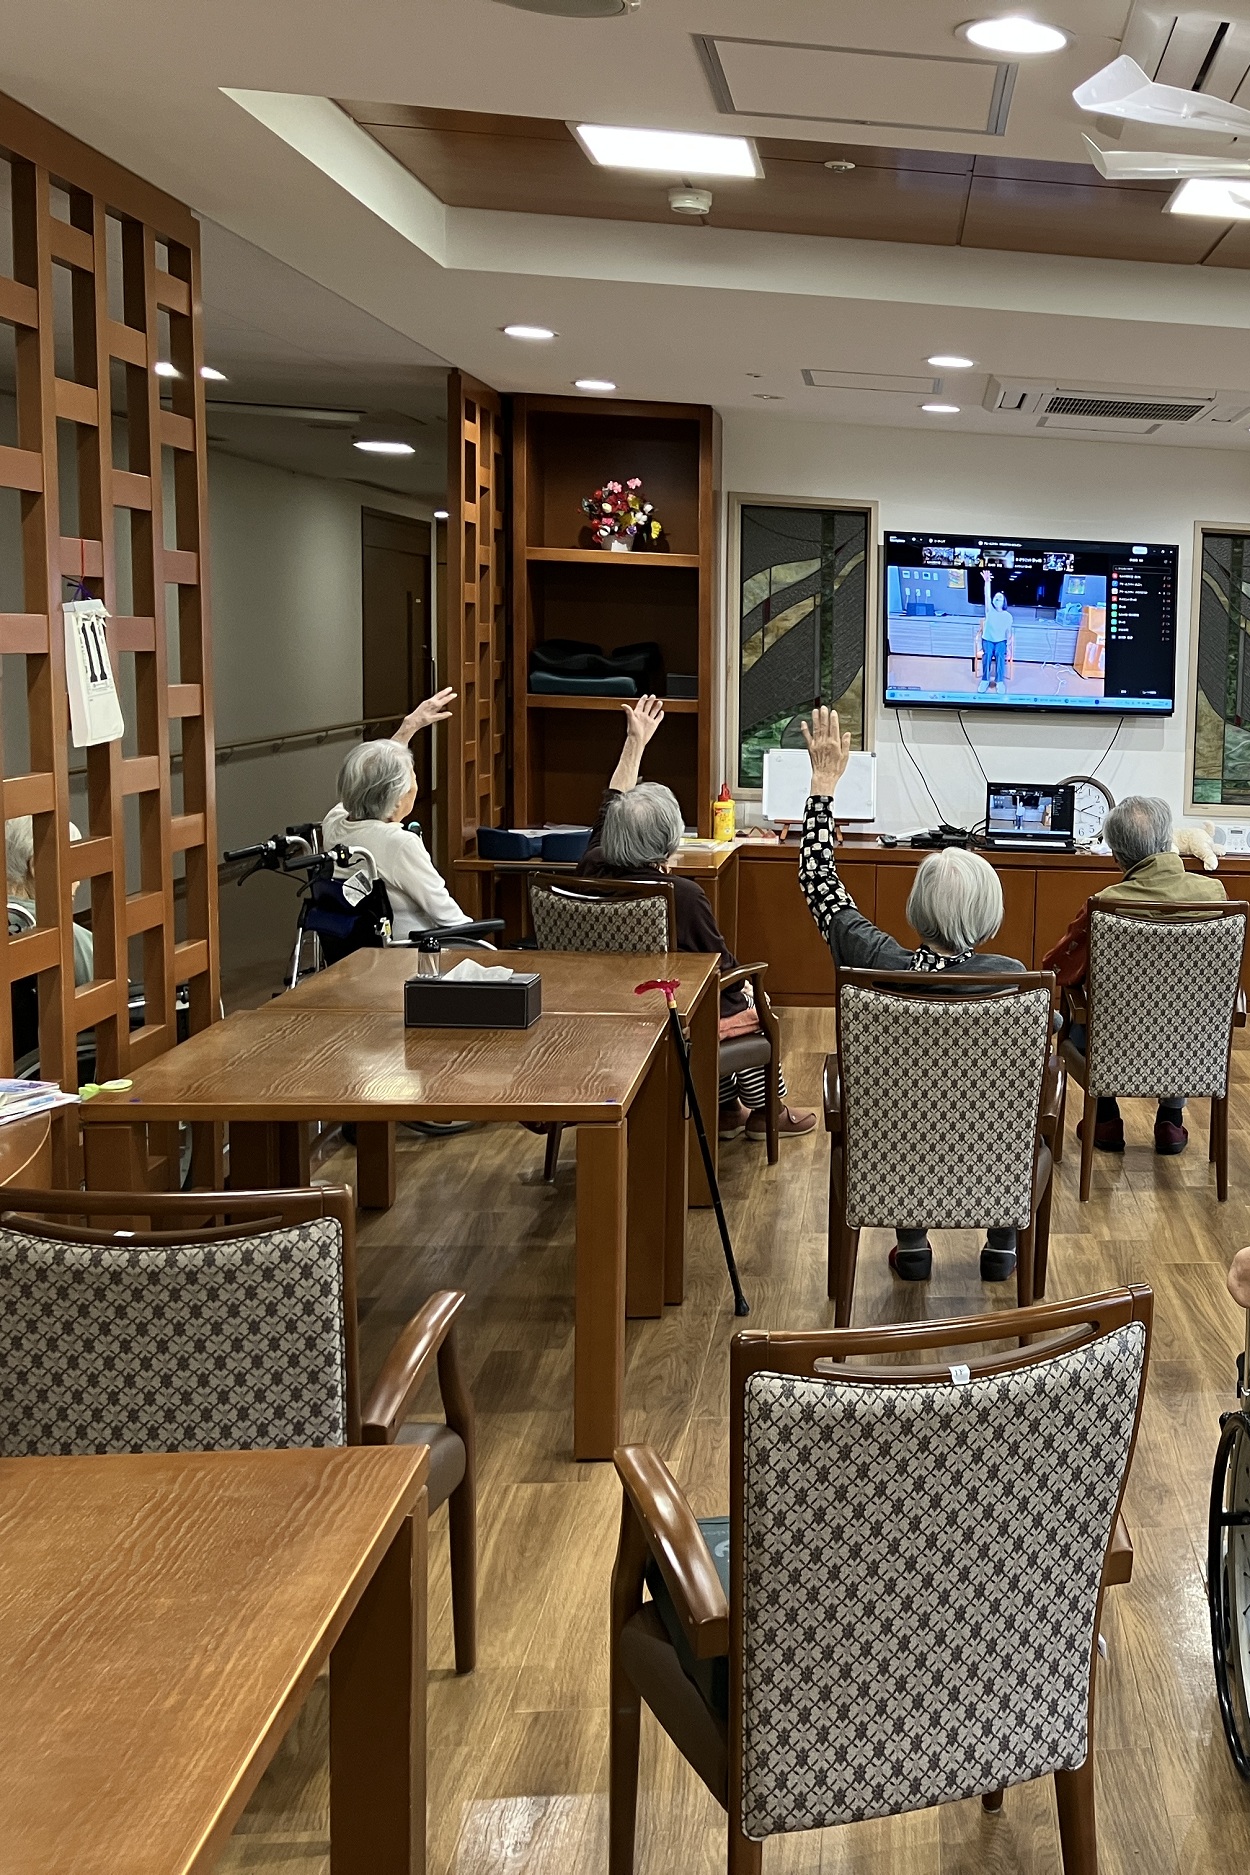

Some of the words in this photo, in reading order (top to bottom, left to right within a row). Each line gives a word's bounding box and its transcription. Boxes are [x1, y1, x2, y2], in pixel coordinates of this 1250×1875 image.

[81, 621, 107, 682] 11
[1094, 795, 1100, 803] 2
[1098, 806, 1105, 814] 3
[1078, 828, 1085, 836] 6
[1089, 825, 1095, 833] 5
